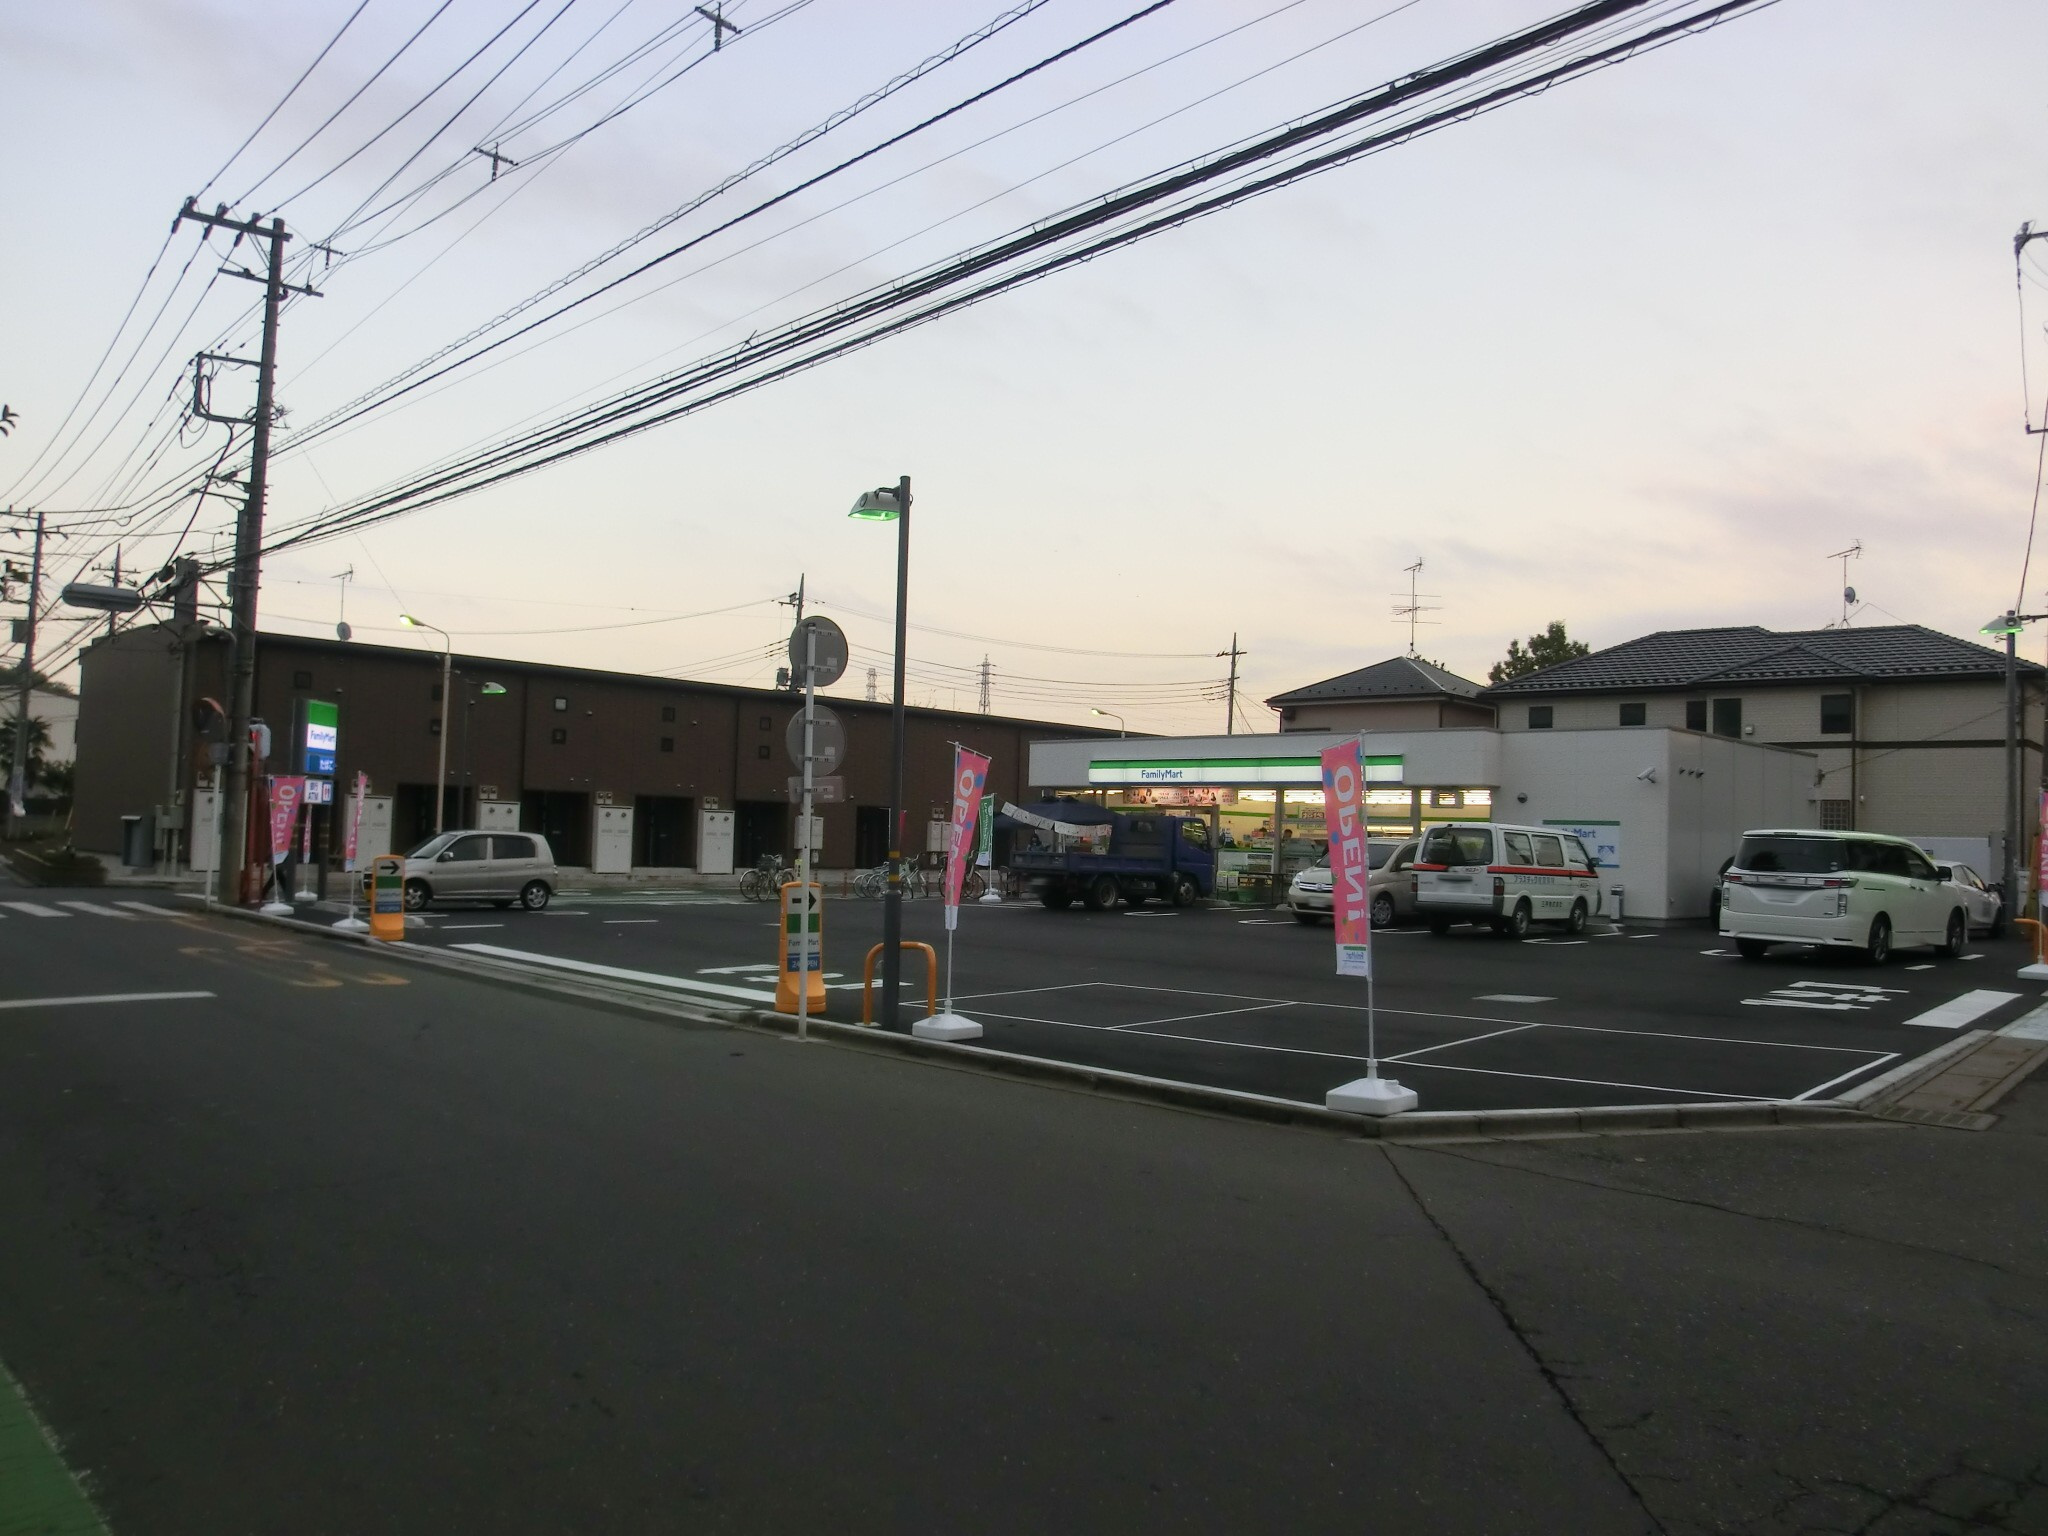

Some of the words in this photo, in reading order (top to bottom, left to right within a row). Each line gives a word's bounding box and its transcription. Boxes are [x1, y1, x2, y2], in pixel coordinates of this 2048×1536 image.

[310, 730, 335, 743] FamilyMart
[1141, 769, 1183, 781] FamilyMart
[788, 938, 819, 947] FamMart
